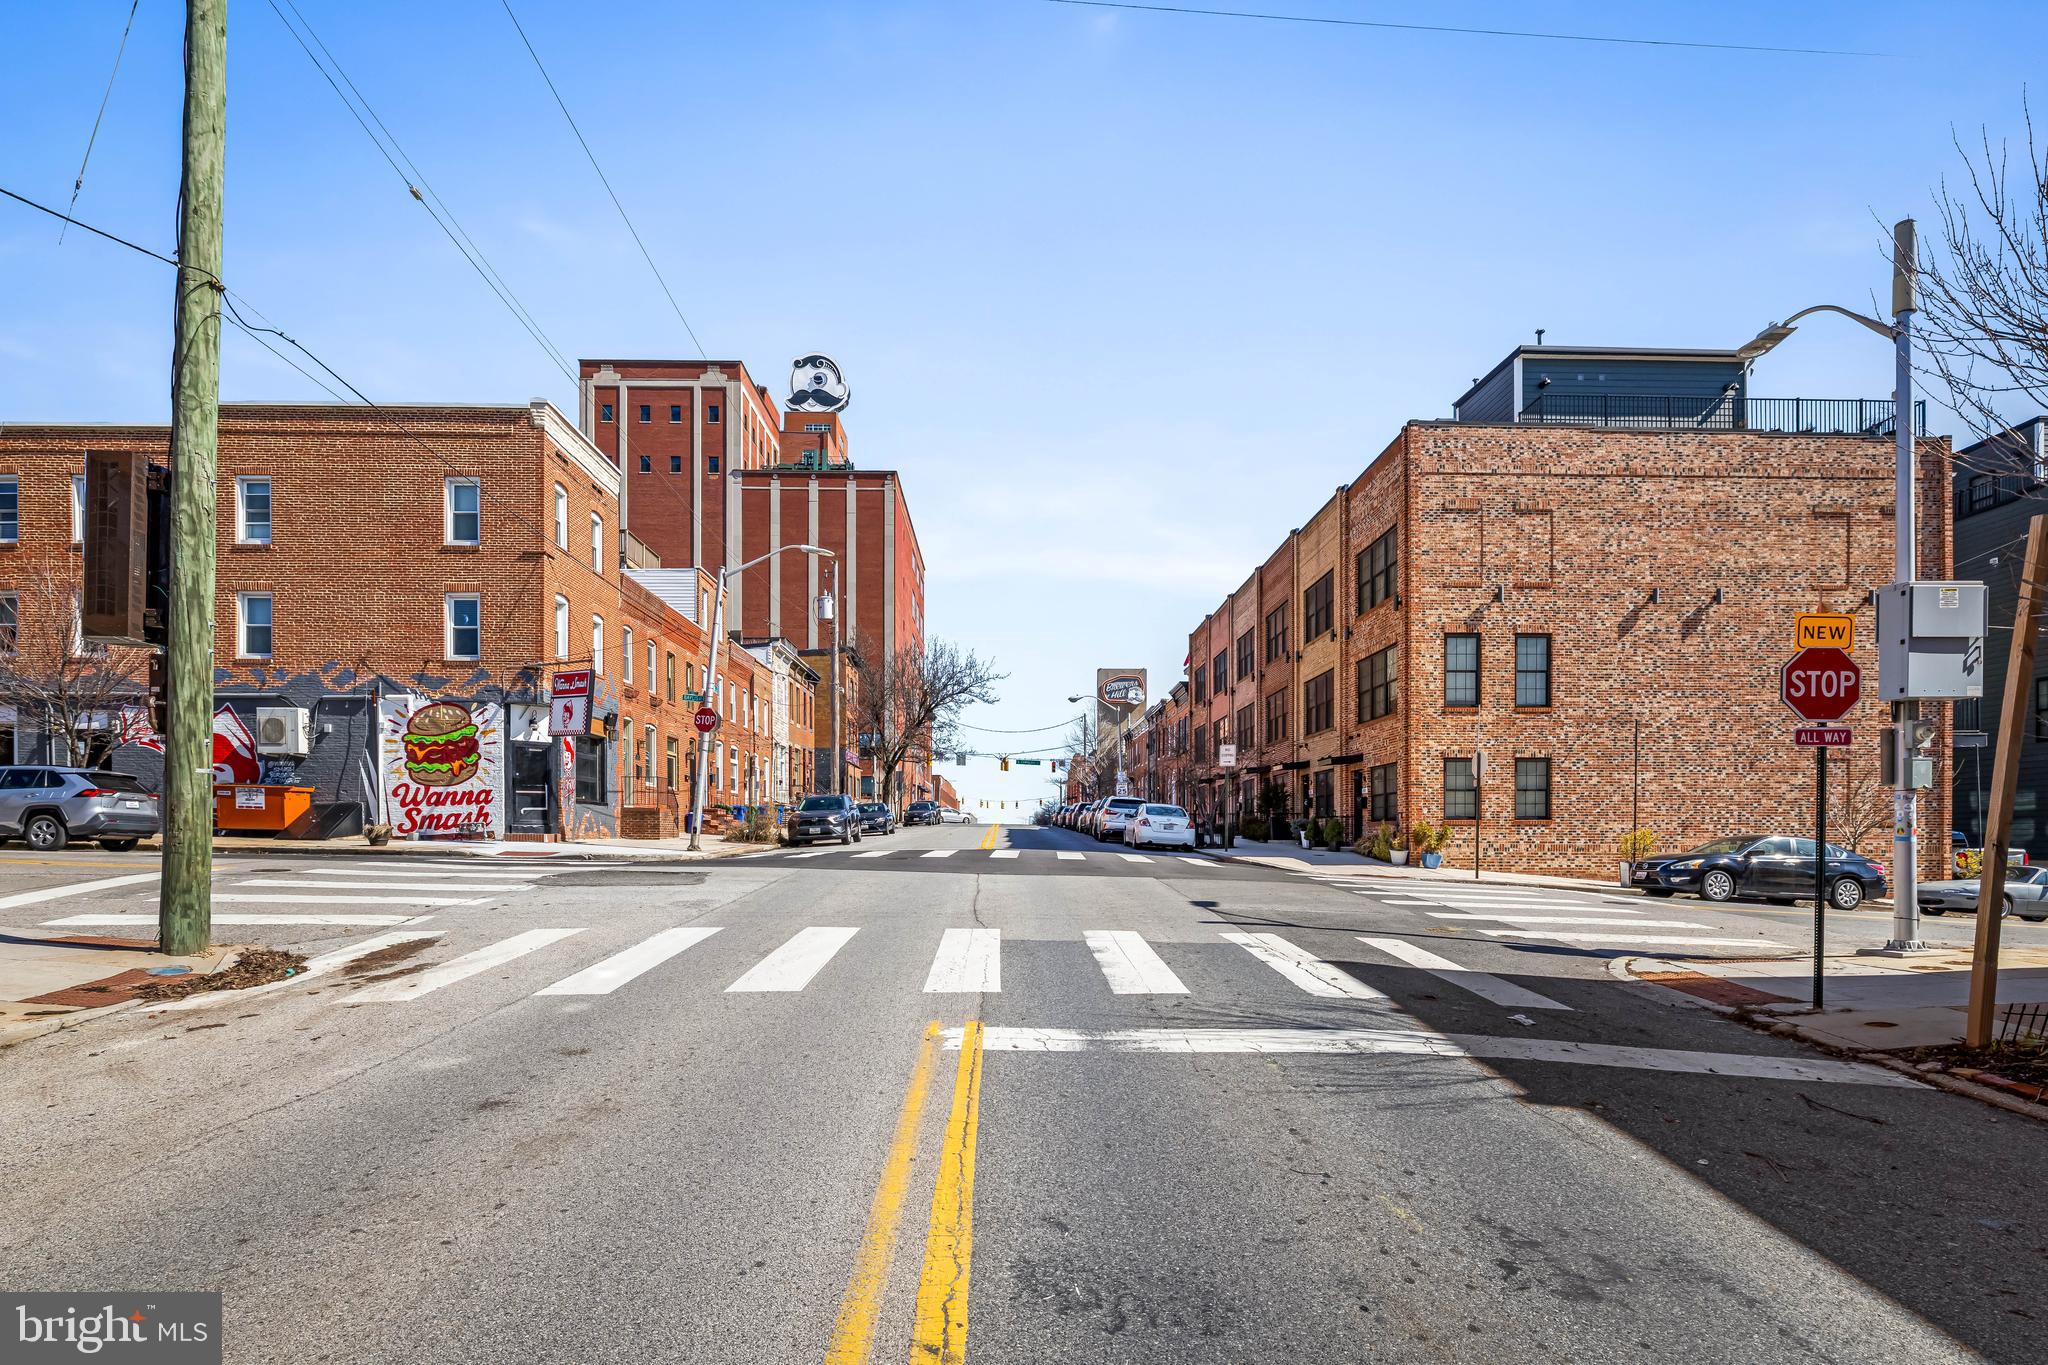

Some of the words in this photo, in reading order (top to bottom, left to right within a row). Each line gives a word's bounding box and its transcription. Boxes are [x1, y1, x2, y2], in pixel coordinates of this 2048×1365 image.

[1804, 626, 1846, 640] NEW
[1790, 670, 1856, 698] STOP
[695, 714, 716, 725] STOP
[1800, 732, 1820, 743] ALL
[1824, 732, 1847, 743] WAY
[392, 783, 495, 808] Wanna
[397, 805, 493, 833] Smash
